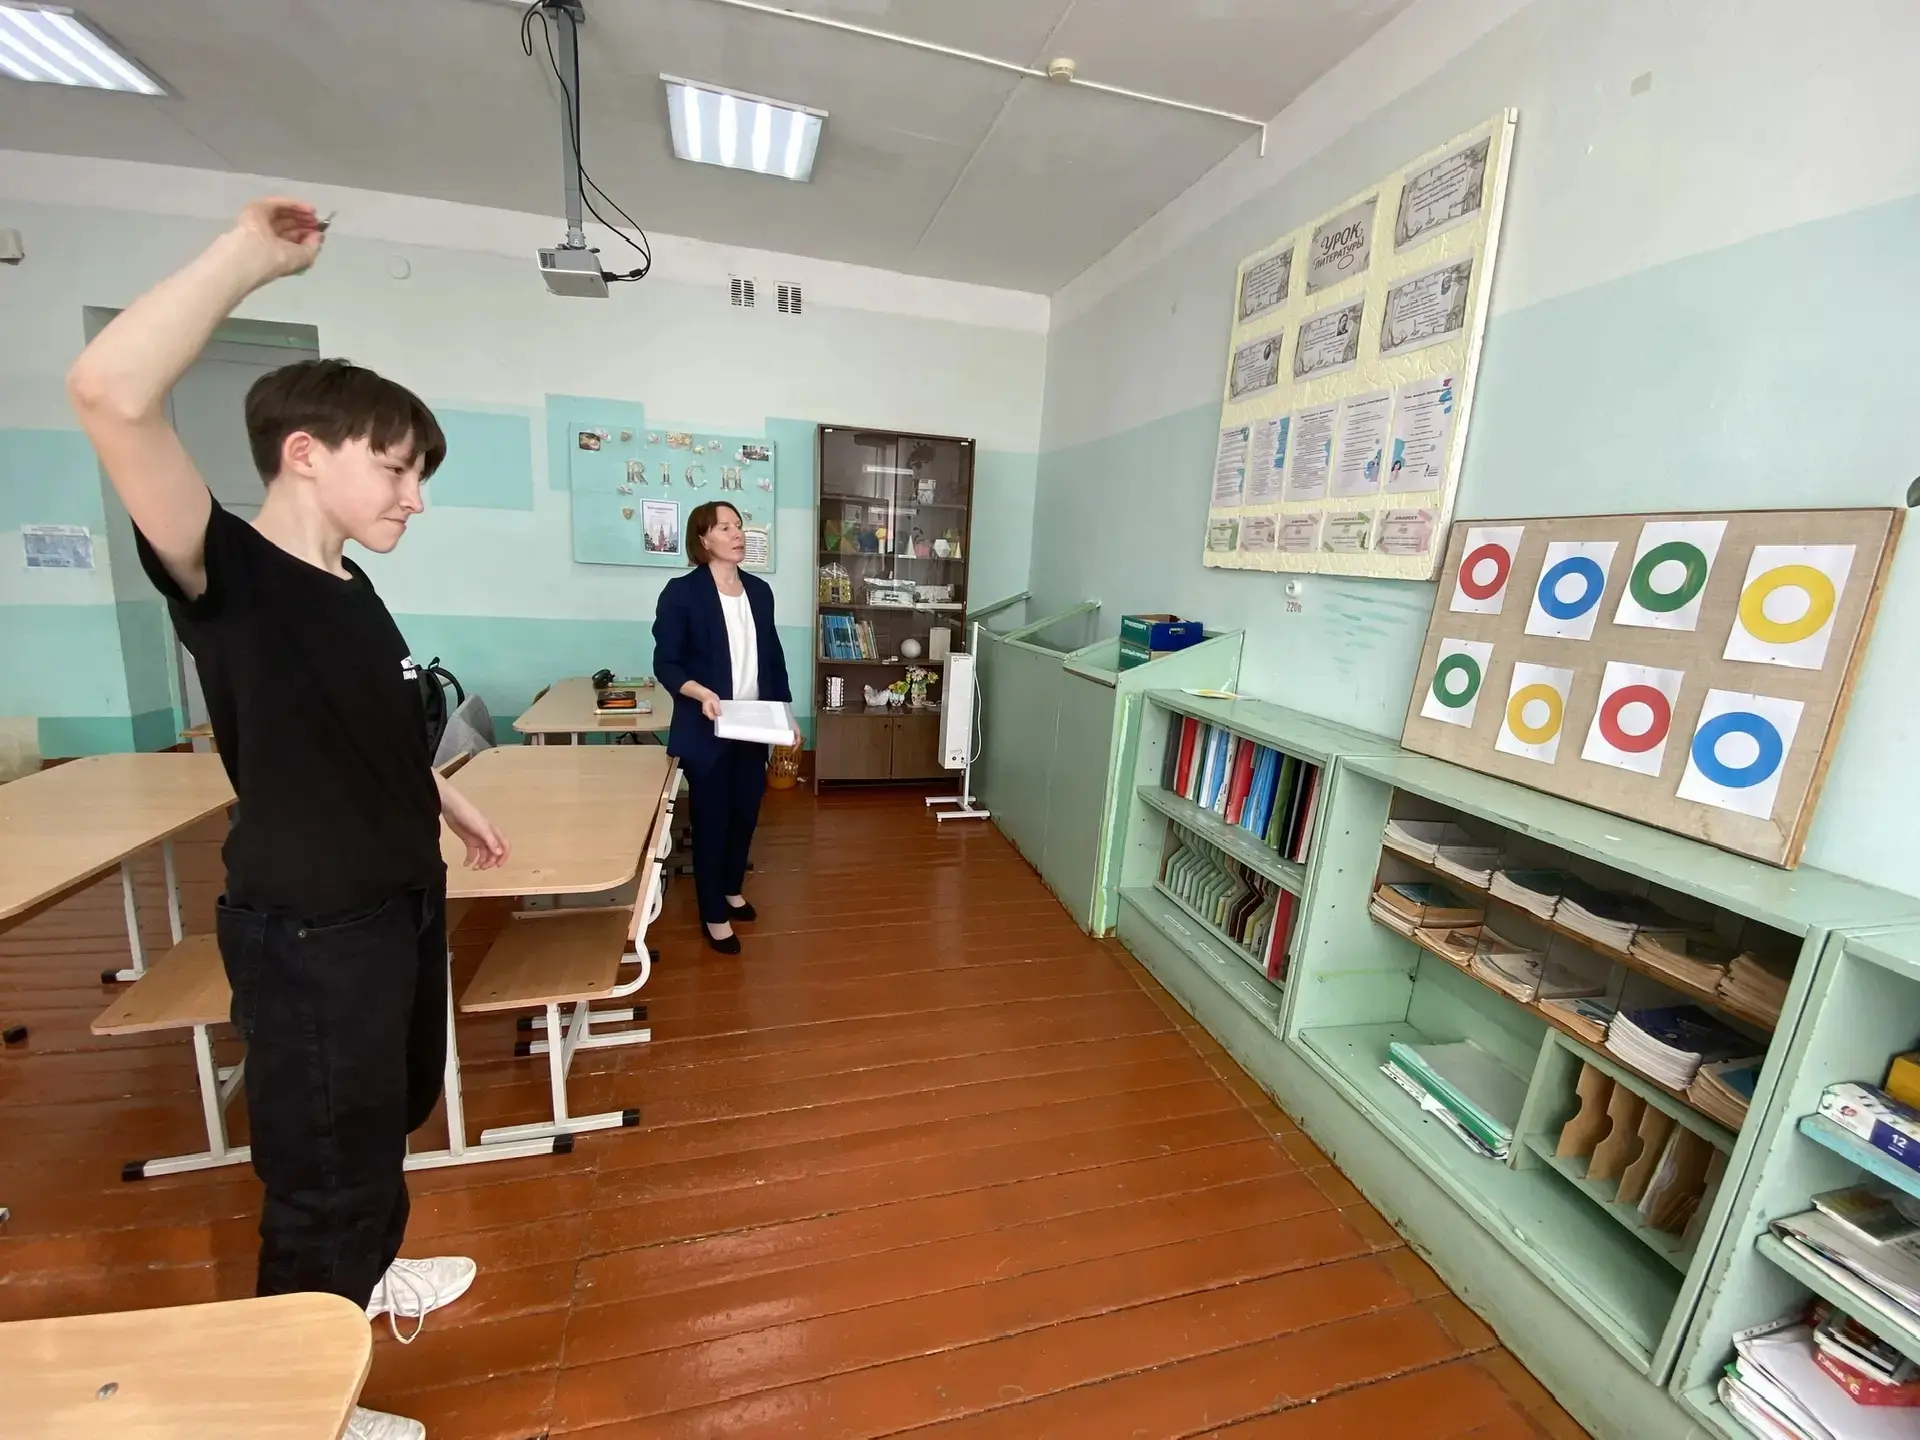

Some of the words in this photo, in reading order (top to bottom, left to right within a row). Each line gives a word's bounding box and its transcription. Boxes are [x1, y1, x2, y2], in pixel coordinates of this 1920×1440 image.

[1312, 235, 1364, 271] ЛИТЕРАТУРЫ
[1320, 220, 1363, 256] УРОК
[625, 459, 744, 492] RICH
[1891, 1134, 1908, 1149] 12
